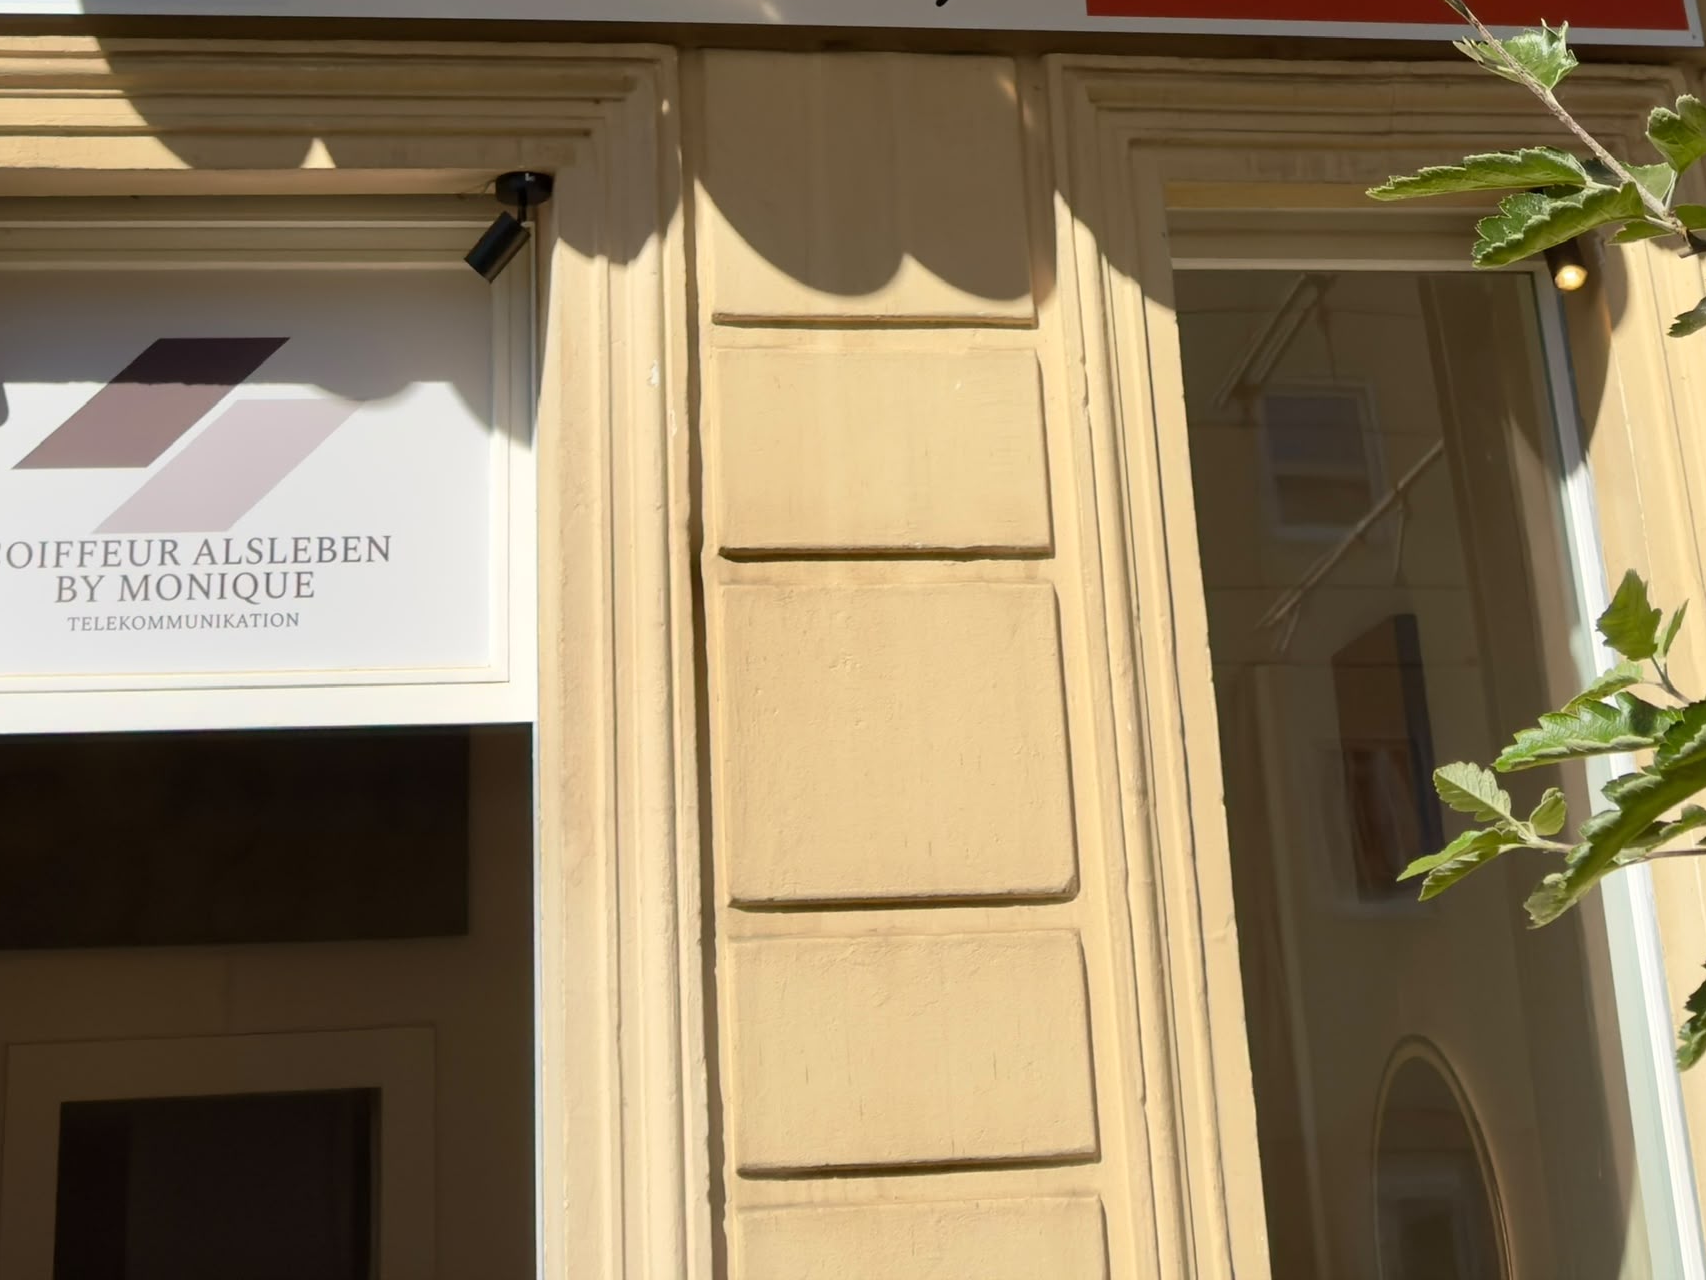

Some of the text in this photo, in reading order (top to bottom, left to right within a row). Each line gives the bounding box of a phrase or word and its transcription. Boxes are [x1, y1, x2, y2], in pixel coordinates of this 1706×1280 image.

[192, 535, 392, 567] ALSLEBEN
[54, 570, 315, 606] BY MONIQUE
[67, 612, 300, 632] TELEKOMMUNIKATION
